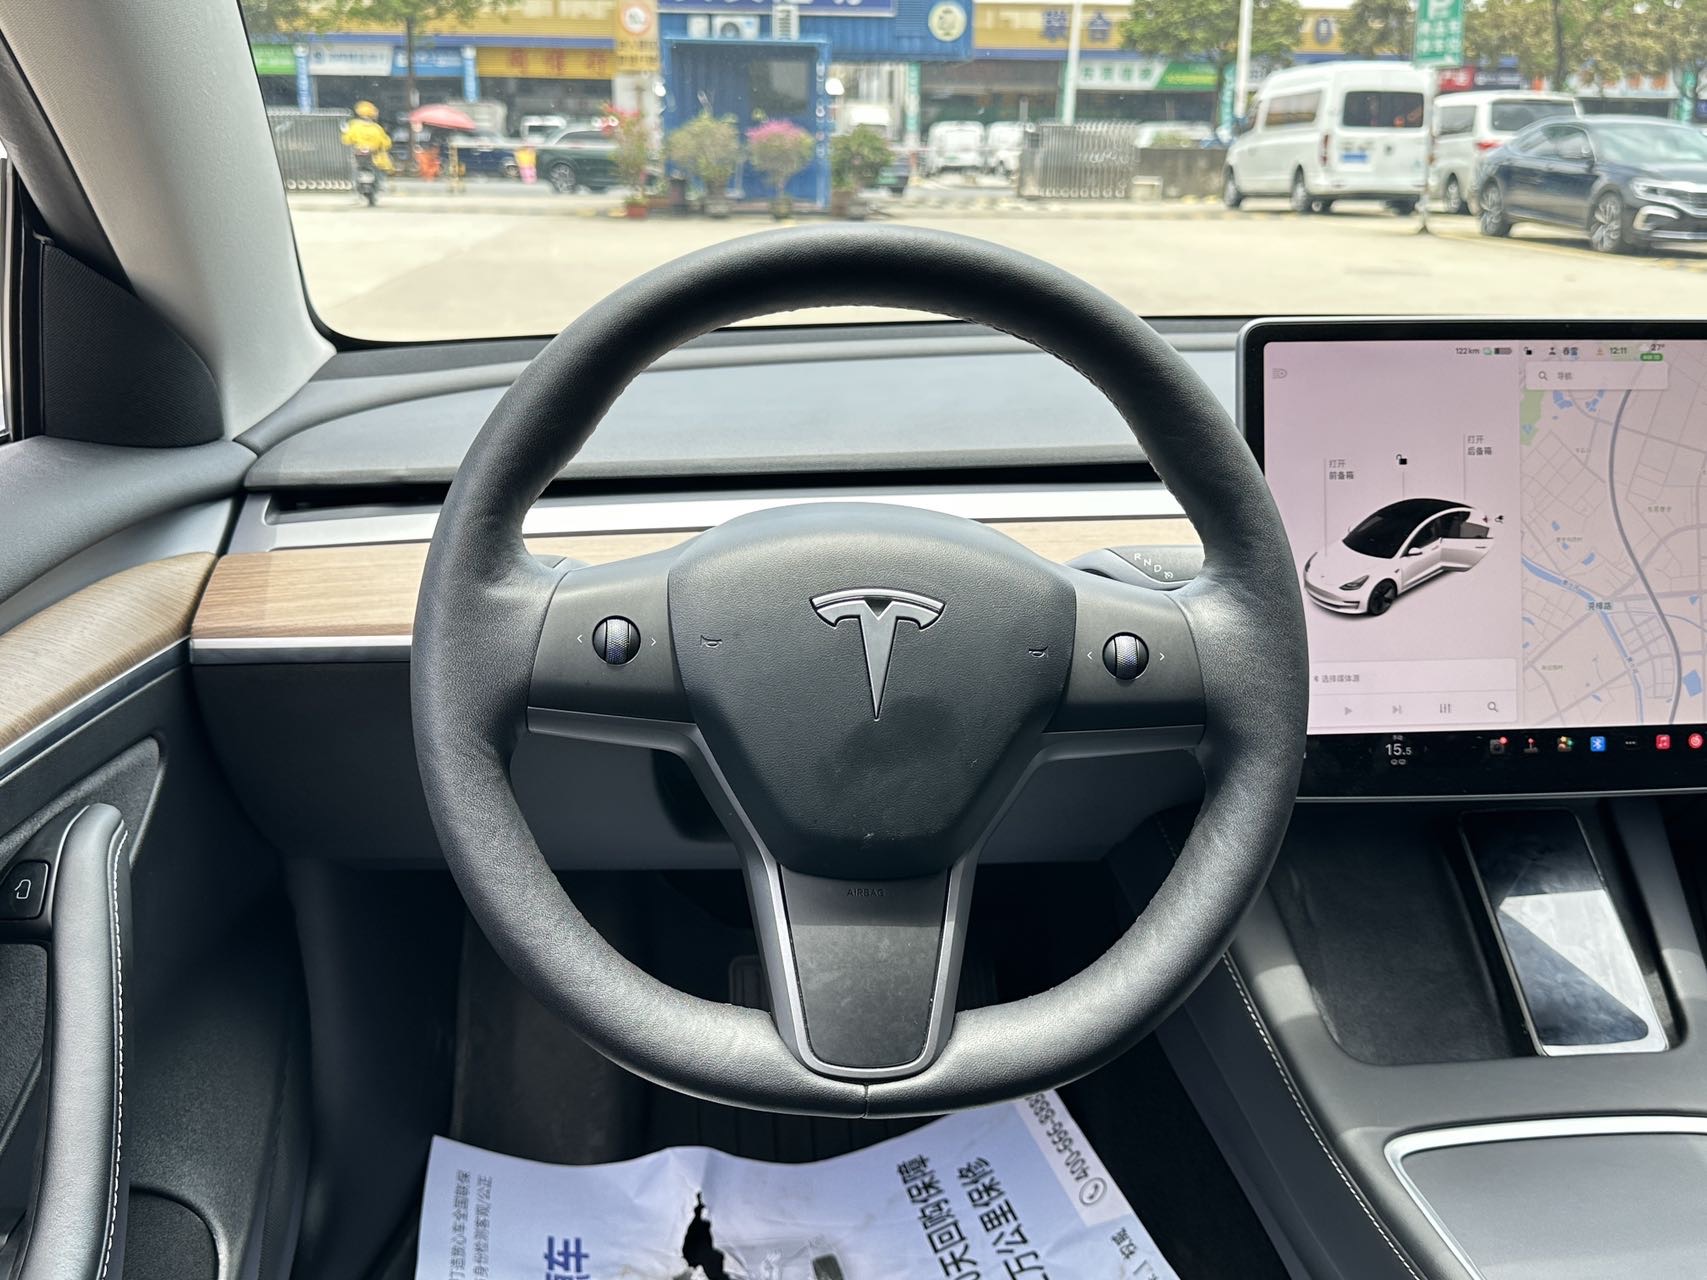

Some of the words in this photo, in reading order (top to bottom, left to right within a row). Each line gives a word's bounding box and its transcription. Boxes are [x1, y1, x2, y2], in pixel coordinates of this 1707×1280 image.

[1455, 347, 1469, 355] 122
[1470, 347, 1480, 355] km
[1609, 346, 1628, 355] 12:11
[1468, 435, 1485, 444] 打开
[1328, 459, 1346, 469] 打开
[1134, 552, 1142, 561] R
[1143, 558, 1152, 567] N
[1153, 564, 1162, 573] D
[1385, 743, 1412, 756] 15.5
[846, 888, 884, 897] AIRBAG
[1025, 1093, 1090, 1182] 400-666-888
[957, 1157, 1050, 1280] 万公里保修
[544, 1235, 591, 1280] 车
